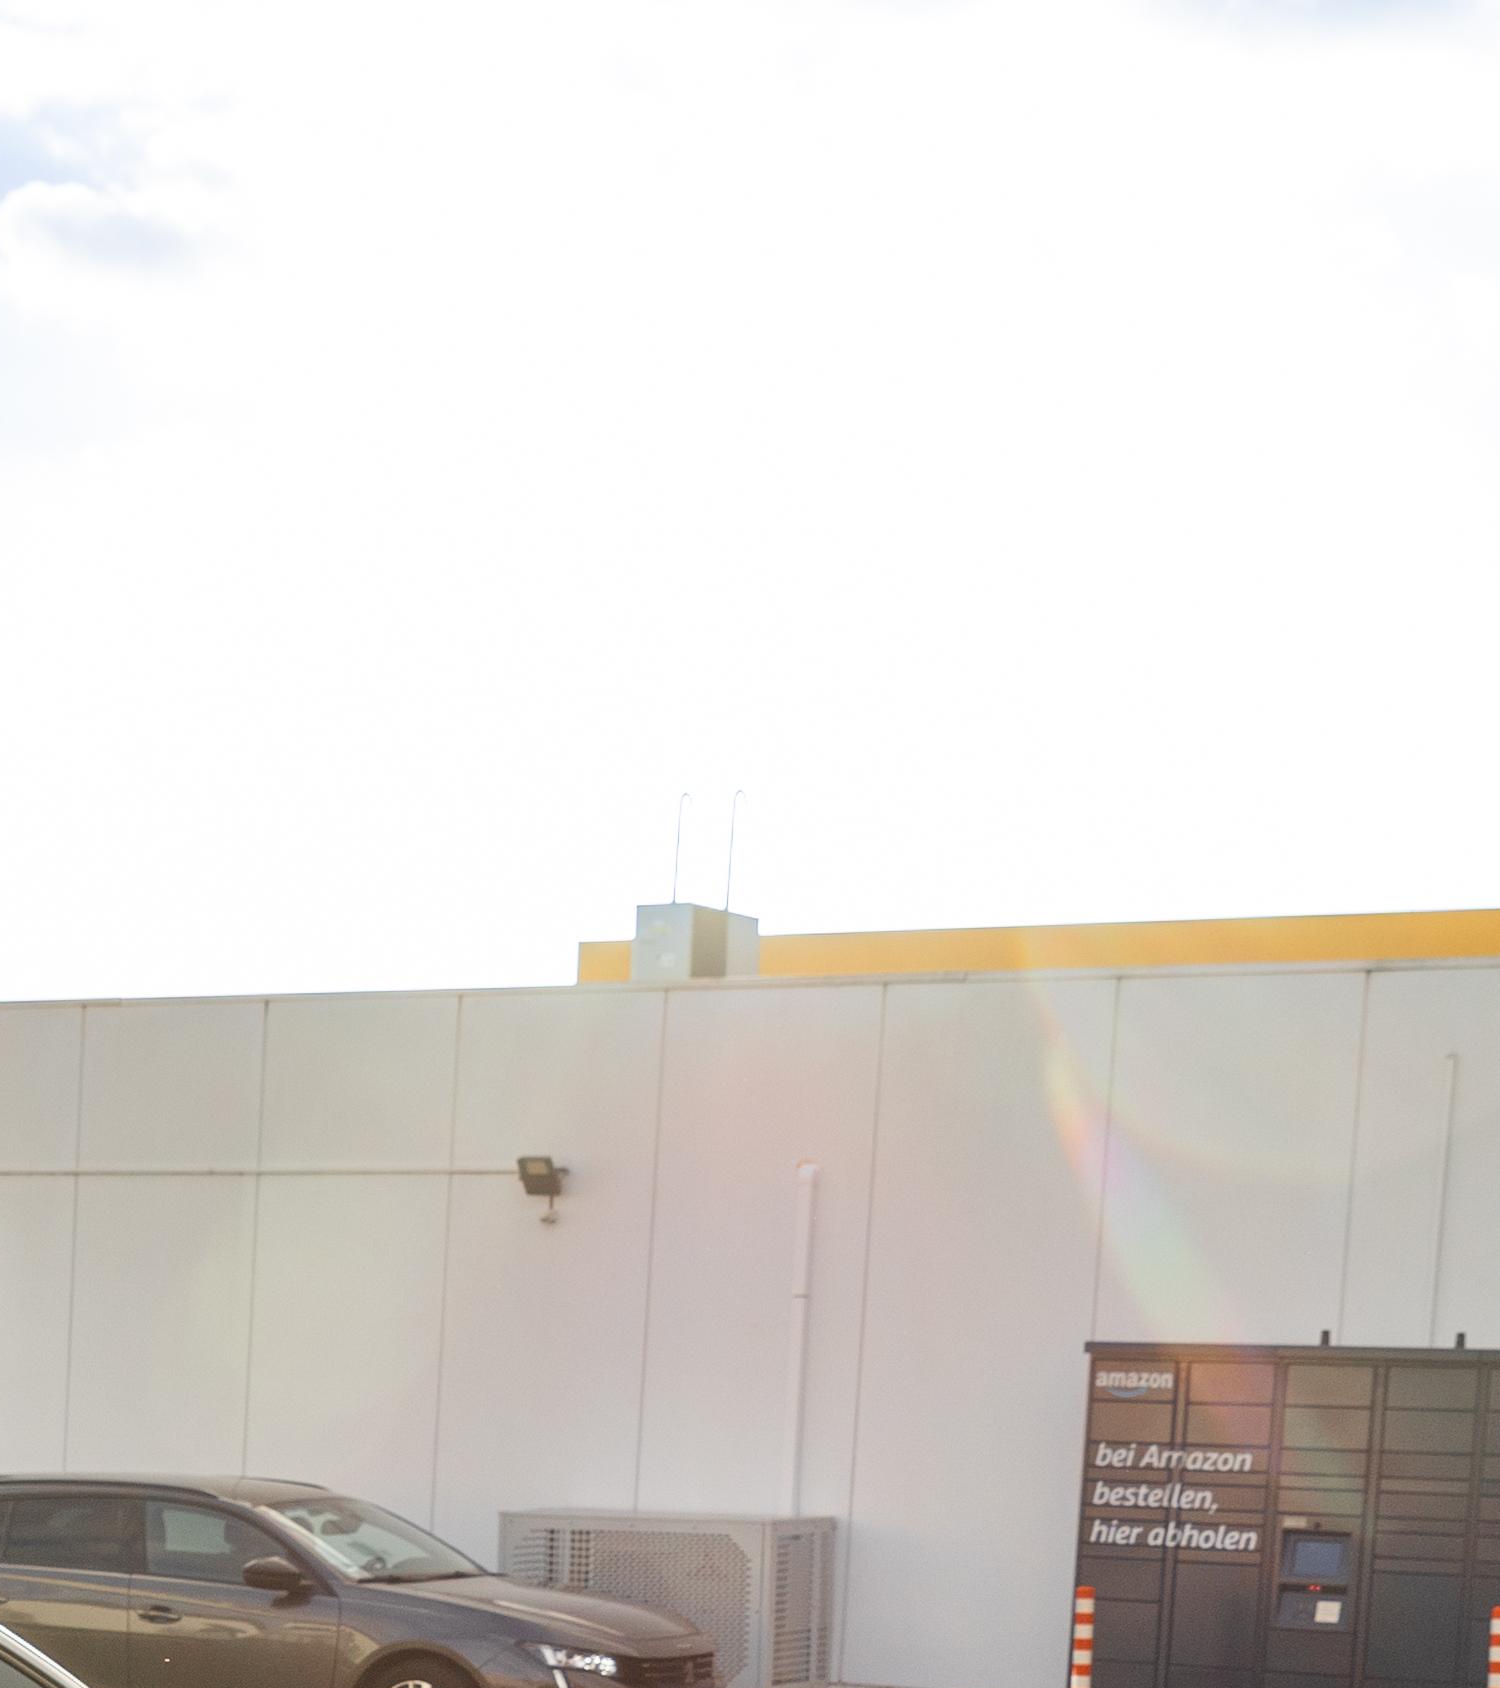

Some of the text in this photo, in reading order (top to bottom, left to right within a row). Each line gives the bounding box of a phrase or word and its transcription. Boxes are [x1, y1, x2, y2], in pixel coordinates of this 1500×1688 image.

[1095, 1371, 1174, 1389] amazon
[1095, 1442, 1253, 1472] bei Amazon
[1092, 1481, 1219, 1515] bestellen,
[1089, 1519, 1258, 1551] hier abholen
